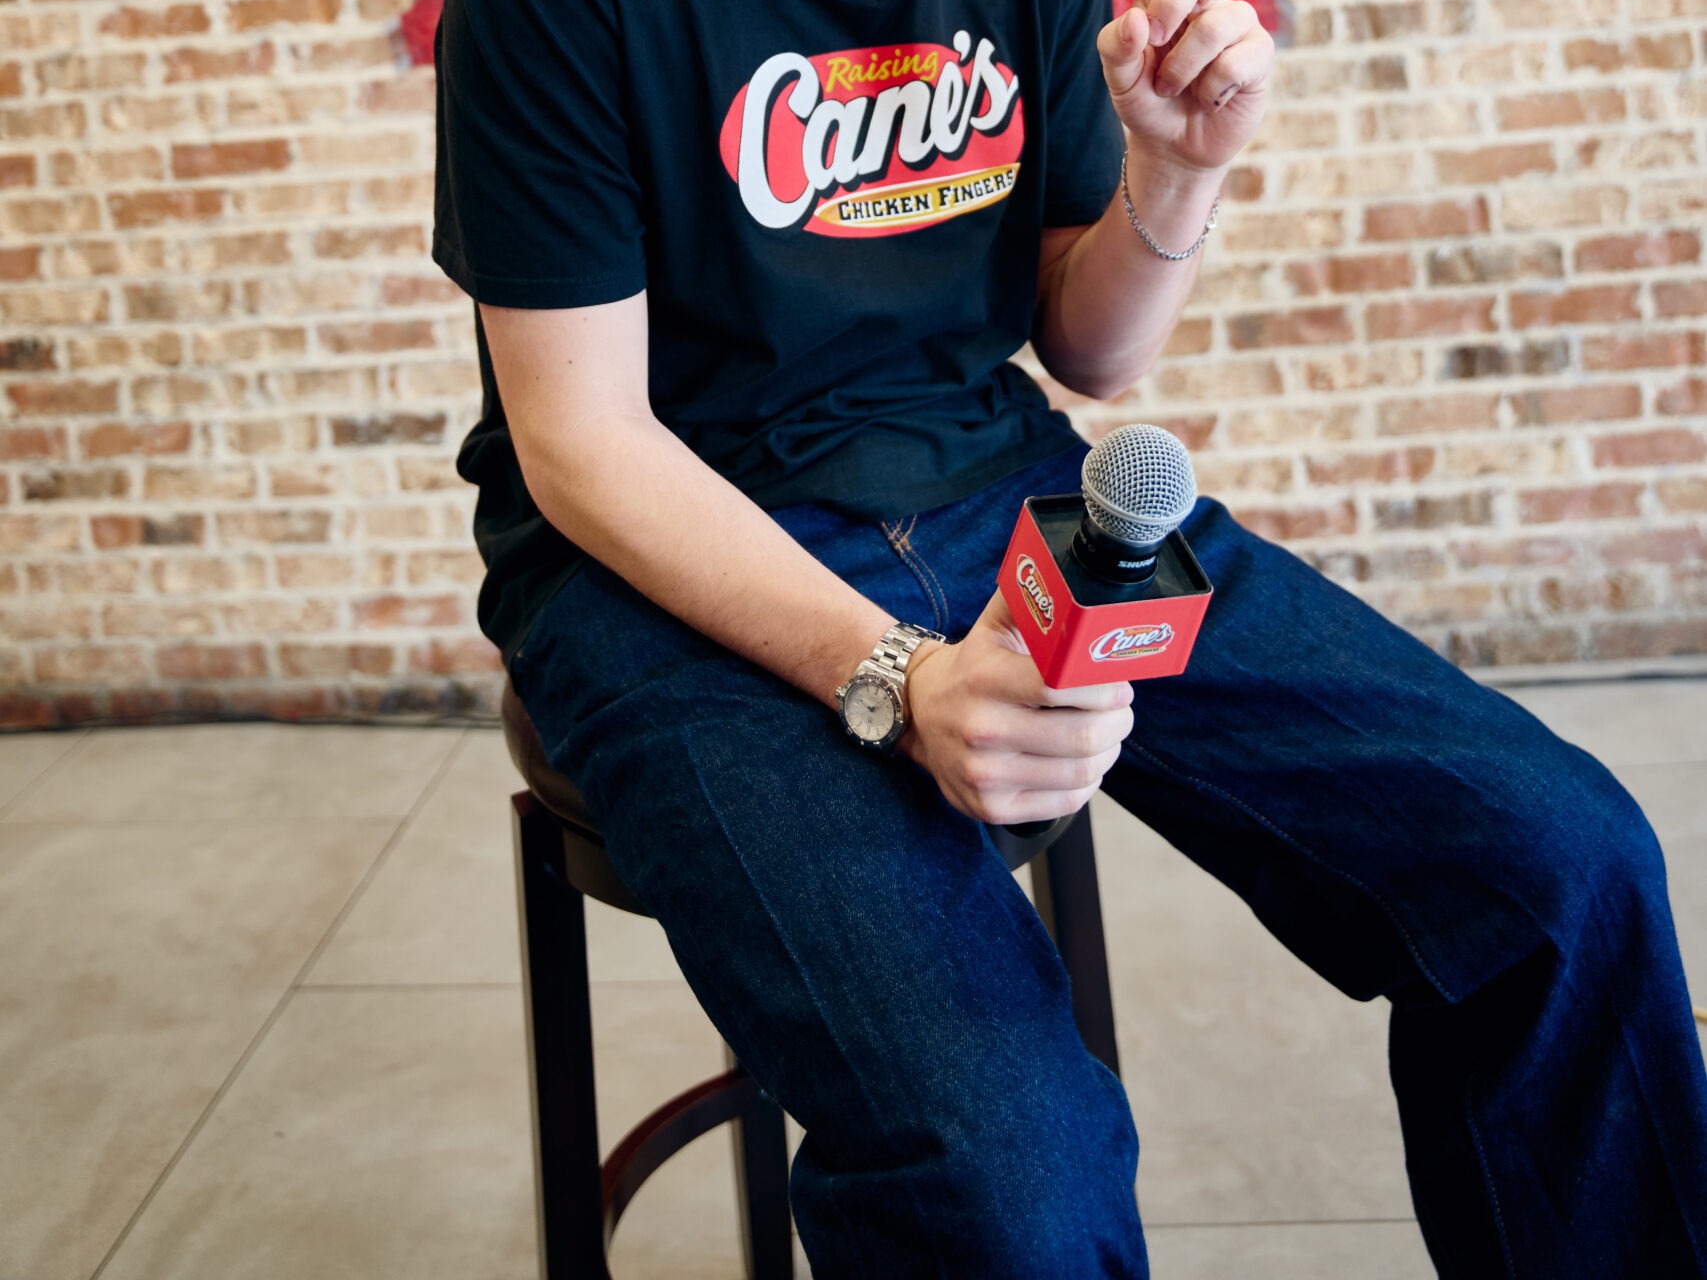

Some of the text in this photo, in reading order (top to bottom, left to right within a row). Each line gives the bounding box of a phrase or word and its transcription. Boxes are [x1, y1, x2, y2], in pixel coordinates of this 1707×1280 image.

[826, 49, 939, 93] Raising
[738, 30, 1019, 229] Cane's
[838, 170, 1014, 221] CHICKEN FINGERS
[1016, 558, 1053, 621] Cane's
[1093, 623, 1174, 660] Cane's
